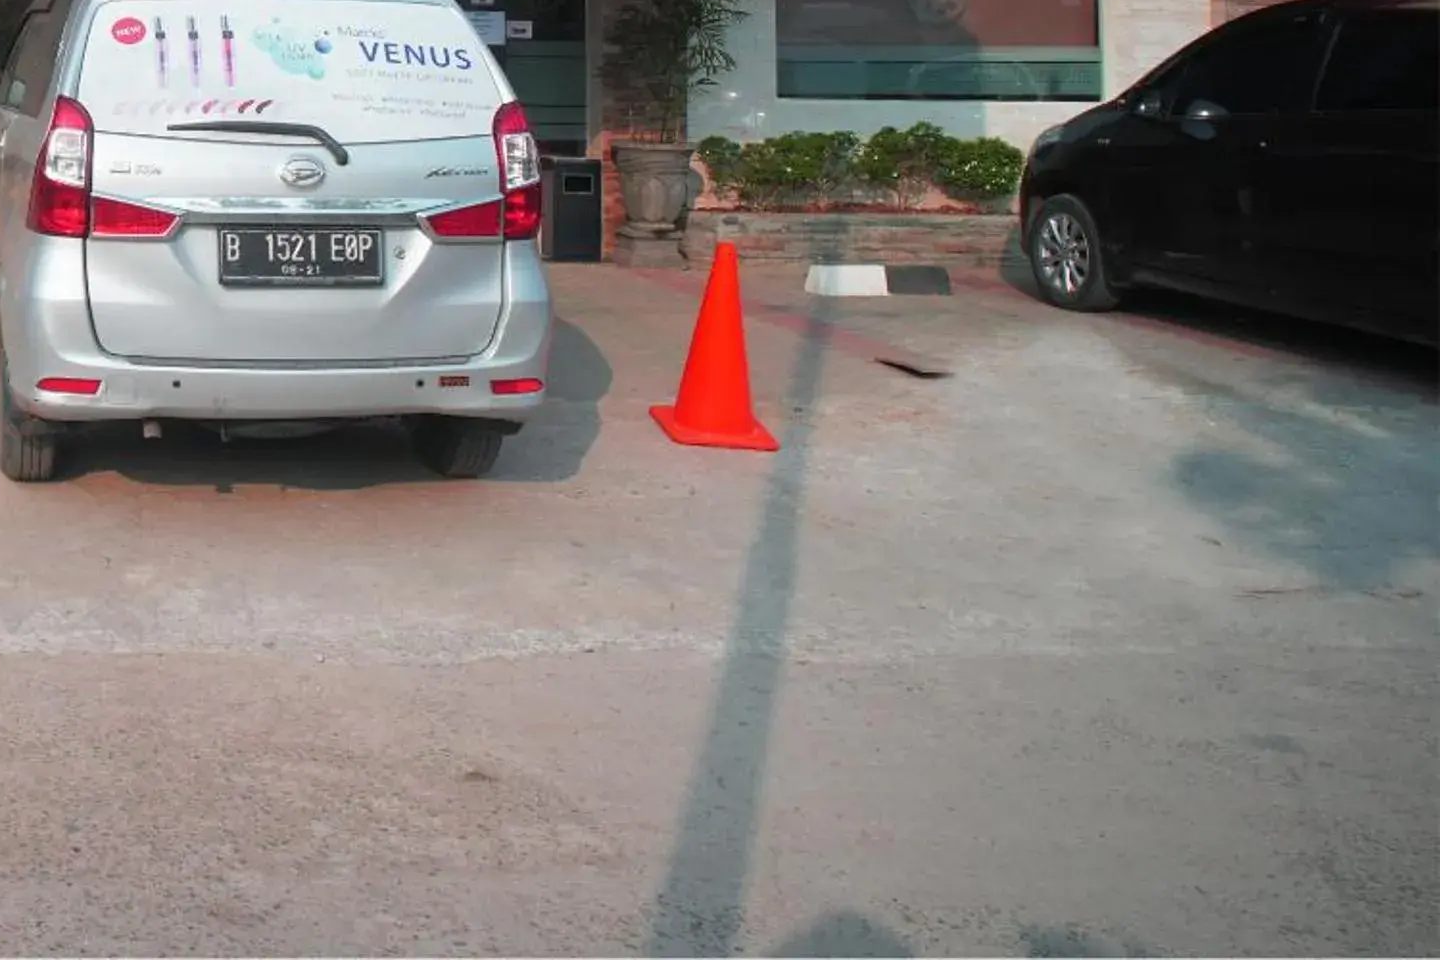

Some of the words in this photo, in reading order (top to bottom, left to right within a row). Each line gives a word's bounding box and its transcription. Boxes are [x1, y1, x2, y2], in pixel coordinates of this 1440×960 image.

[359, 41, 472, 70] VENUS
[226, 234, 240, 262] B
[265, 234, 317, 262] 1521
